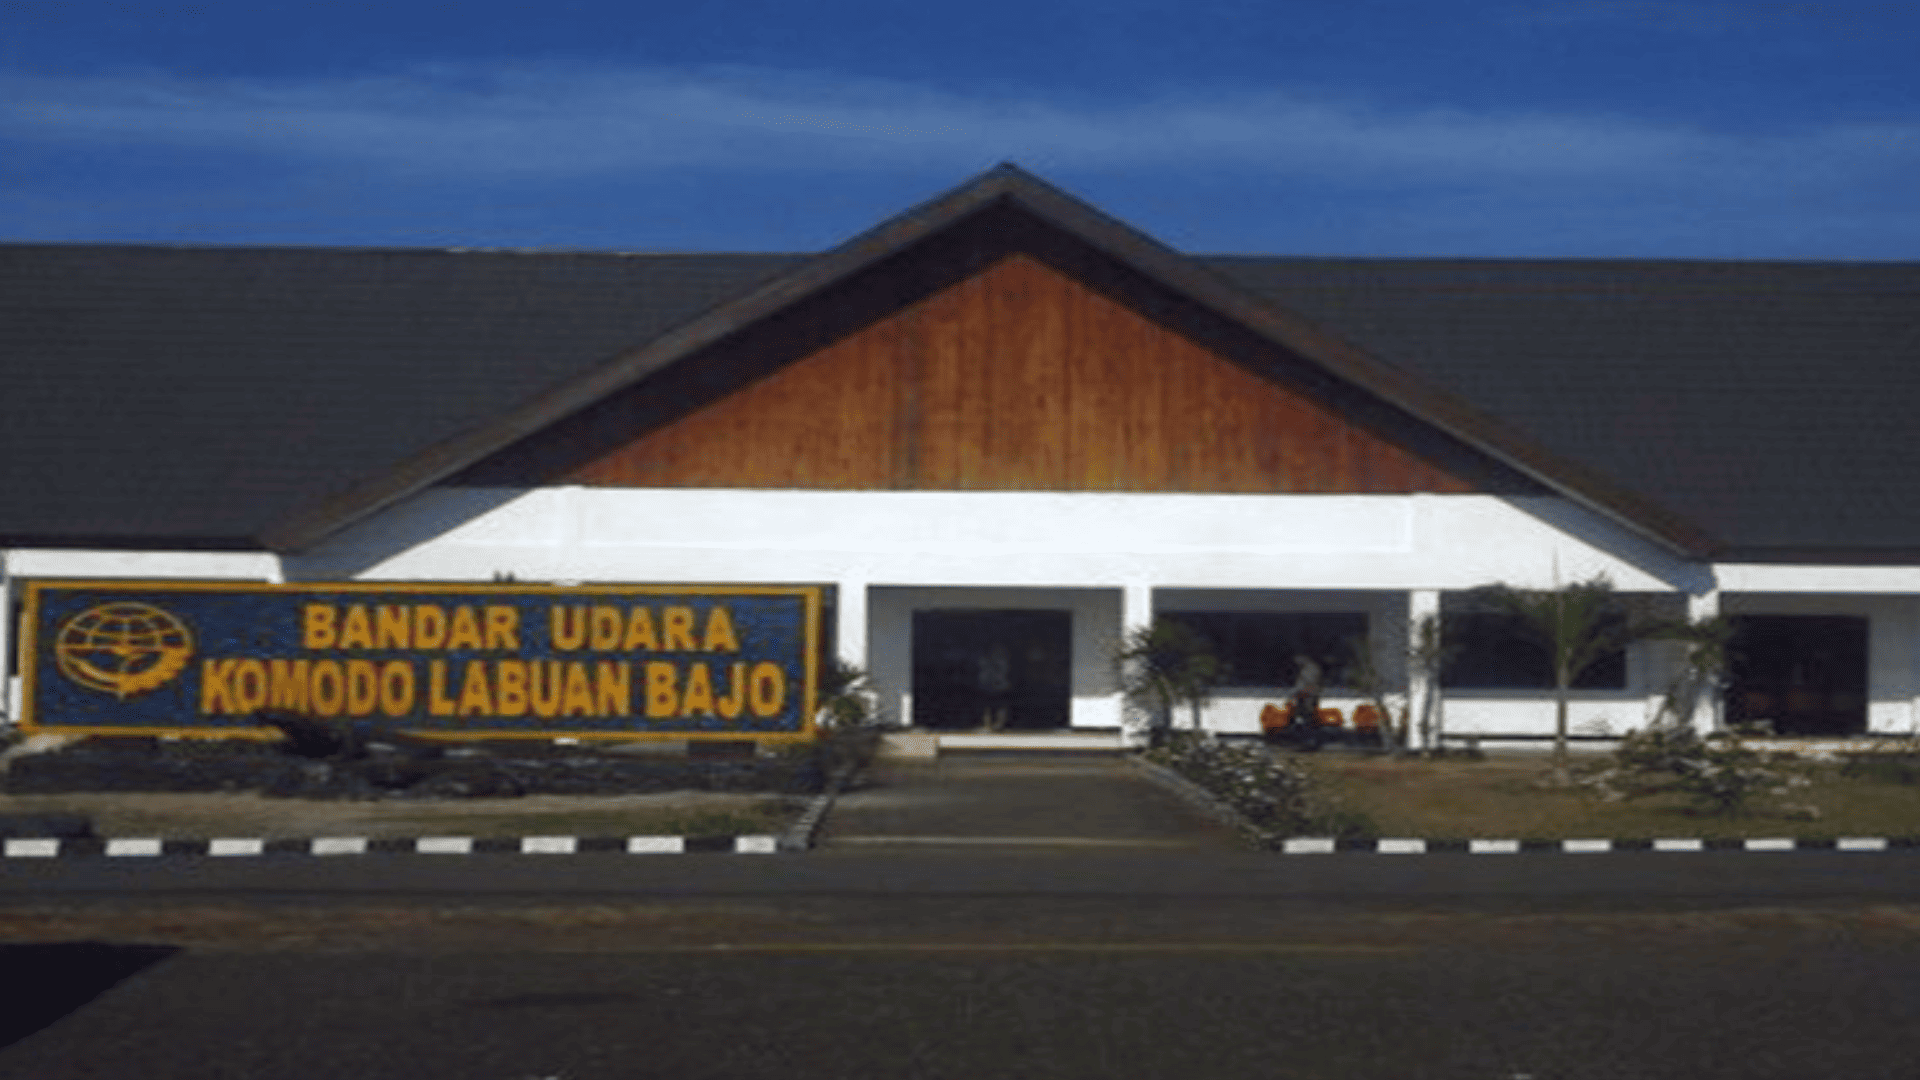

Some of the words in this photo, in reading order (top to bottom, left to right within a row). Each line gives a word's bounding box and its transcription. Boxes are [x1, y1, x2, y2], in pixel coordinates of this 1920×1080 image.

[303, 604, 518, 650] BANDAR
[551, 605, 738, 651] UDARA
[202, 658, 415, 715] KOMODO
[430, 660, 630, 717] LABUAN
[646, 661, 785, 717] BAJO
